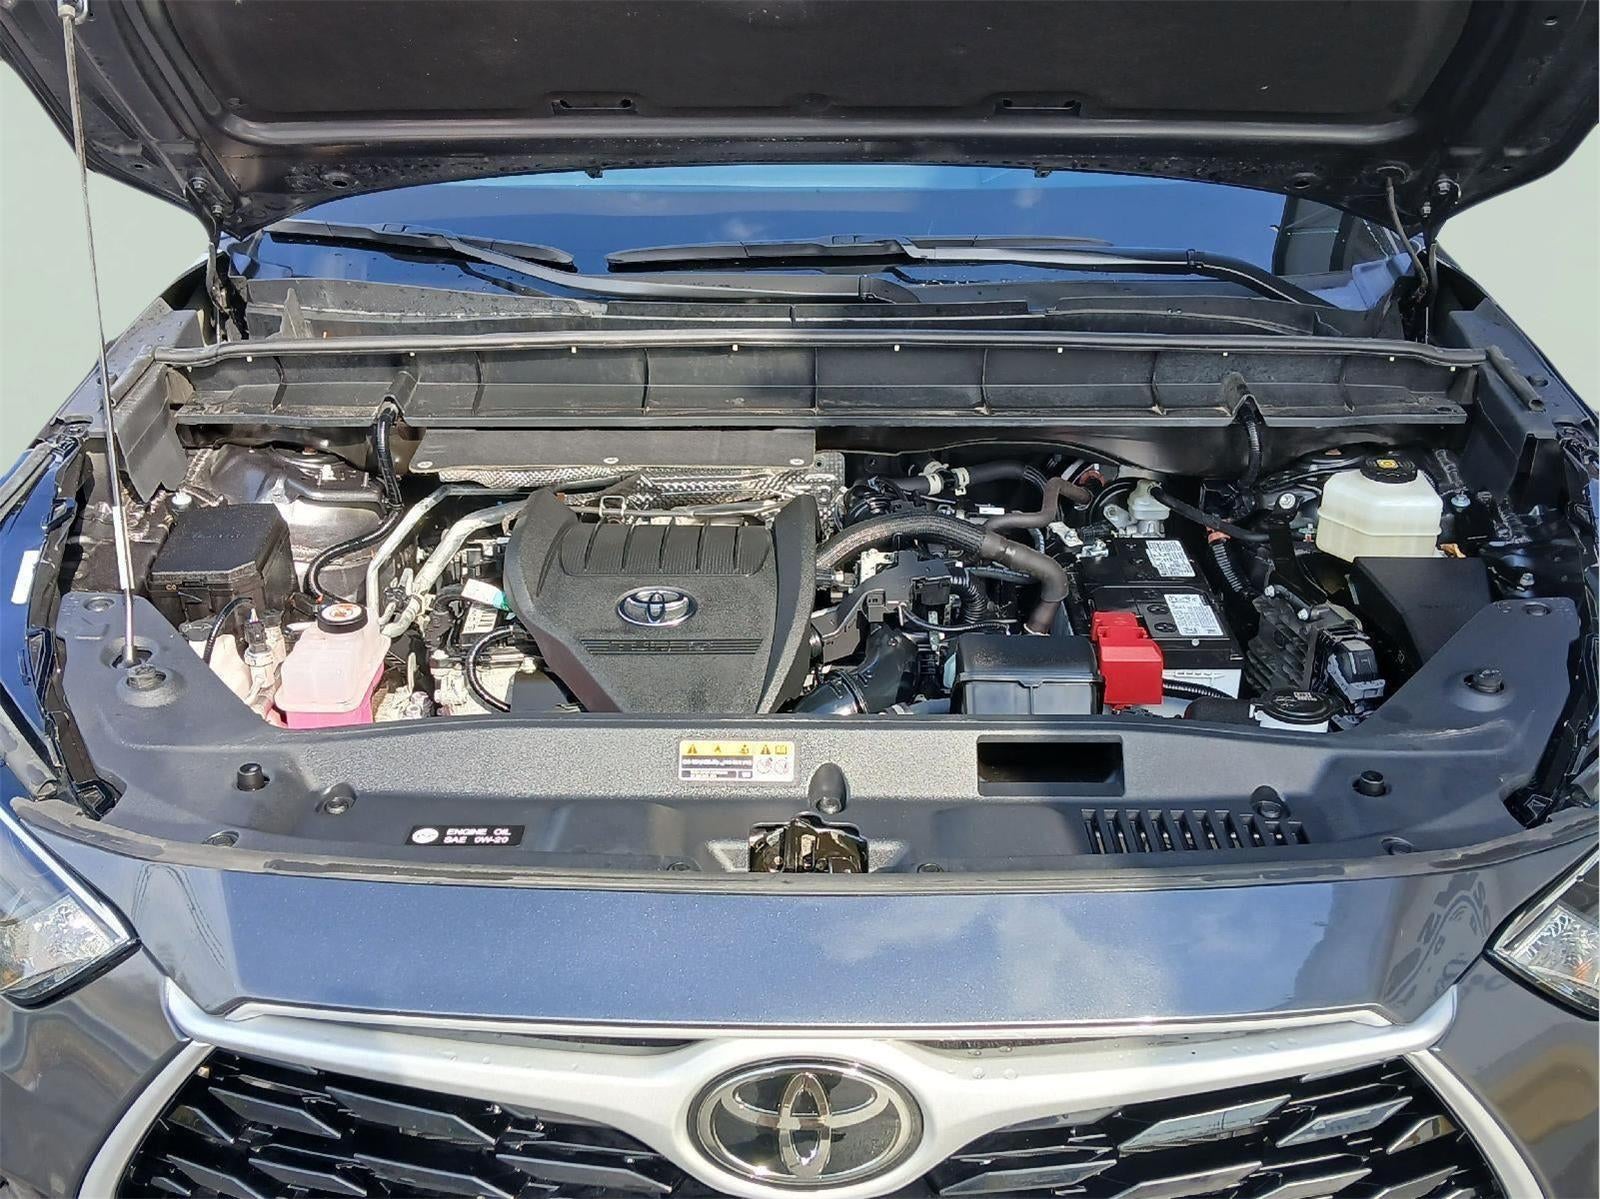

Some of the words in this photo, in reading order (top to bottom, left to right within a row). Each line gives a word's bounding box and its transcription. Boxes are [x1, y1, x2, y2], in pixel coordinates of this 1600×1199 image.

[446, 828, 488, 836] ENGINE
[493, 828, 512, 836] OIL
[443, 836, 468, 844] SAE
[473, 836, 510, 844] 0W-20
